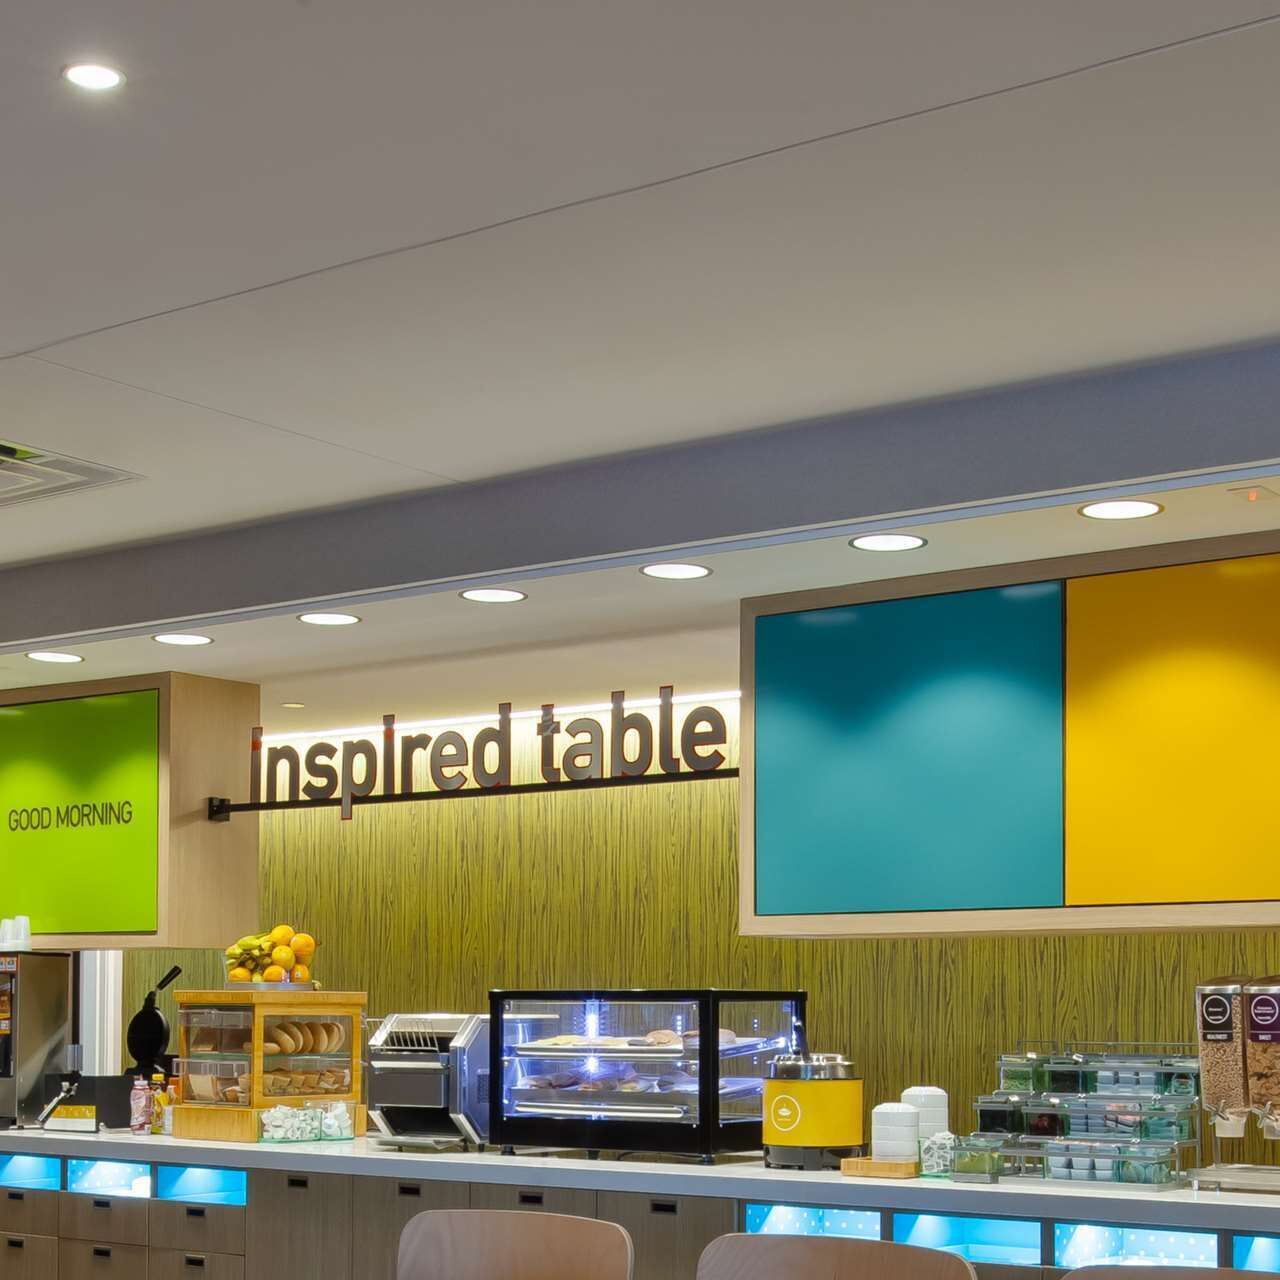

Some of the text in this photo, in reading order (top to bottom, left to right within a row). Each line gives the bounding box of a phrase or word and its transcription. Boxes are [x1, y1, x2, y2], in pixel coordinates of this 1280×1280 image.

[250, 685, 726, 820] inspired table
[8, 801, 132, 831] GOOD MORNING
